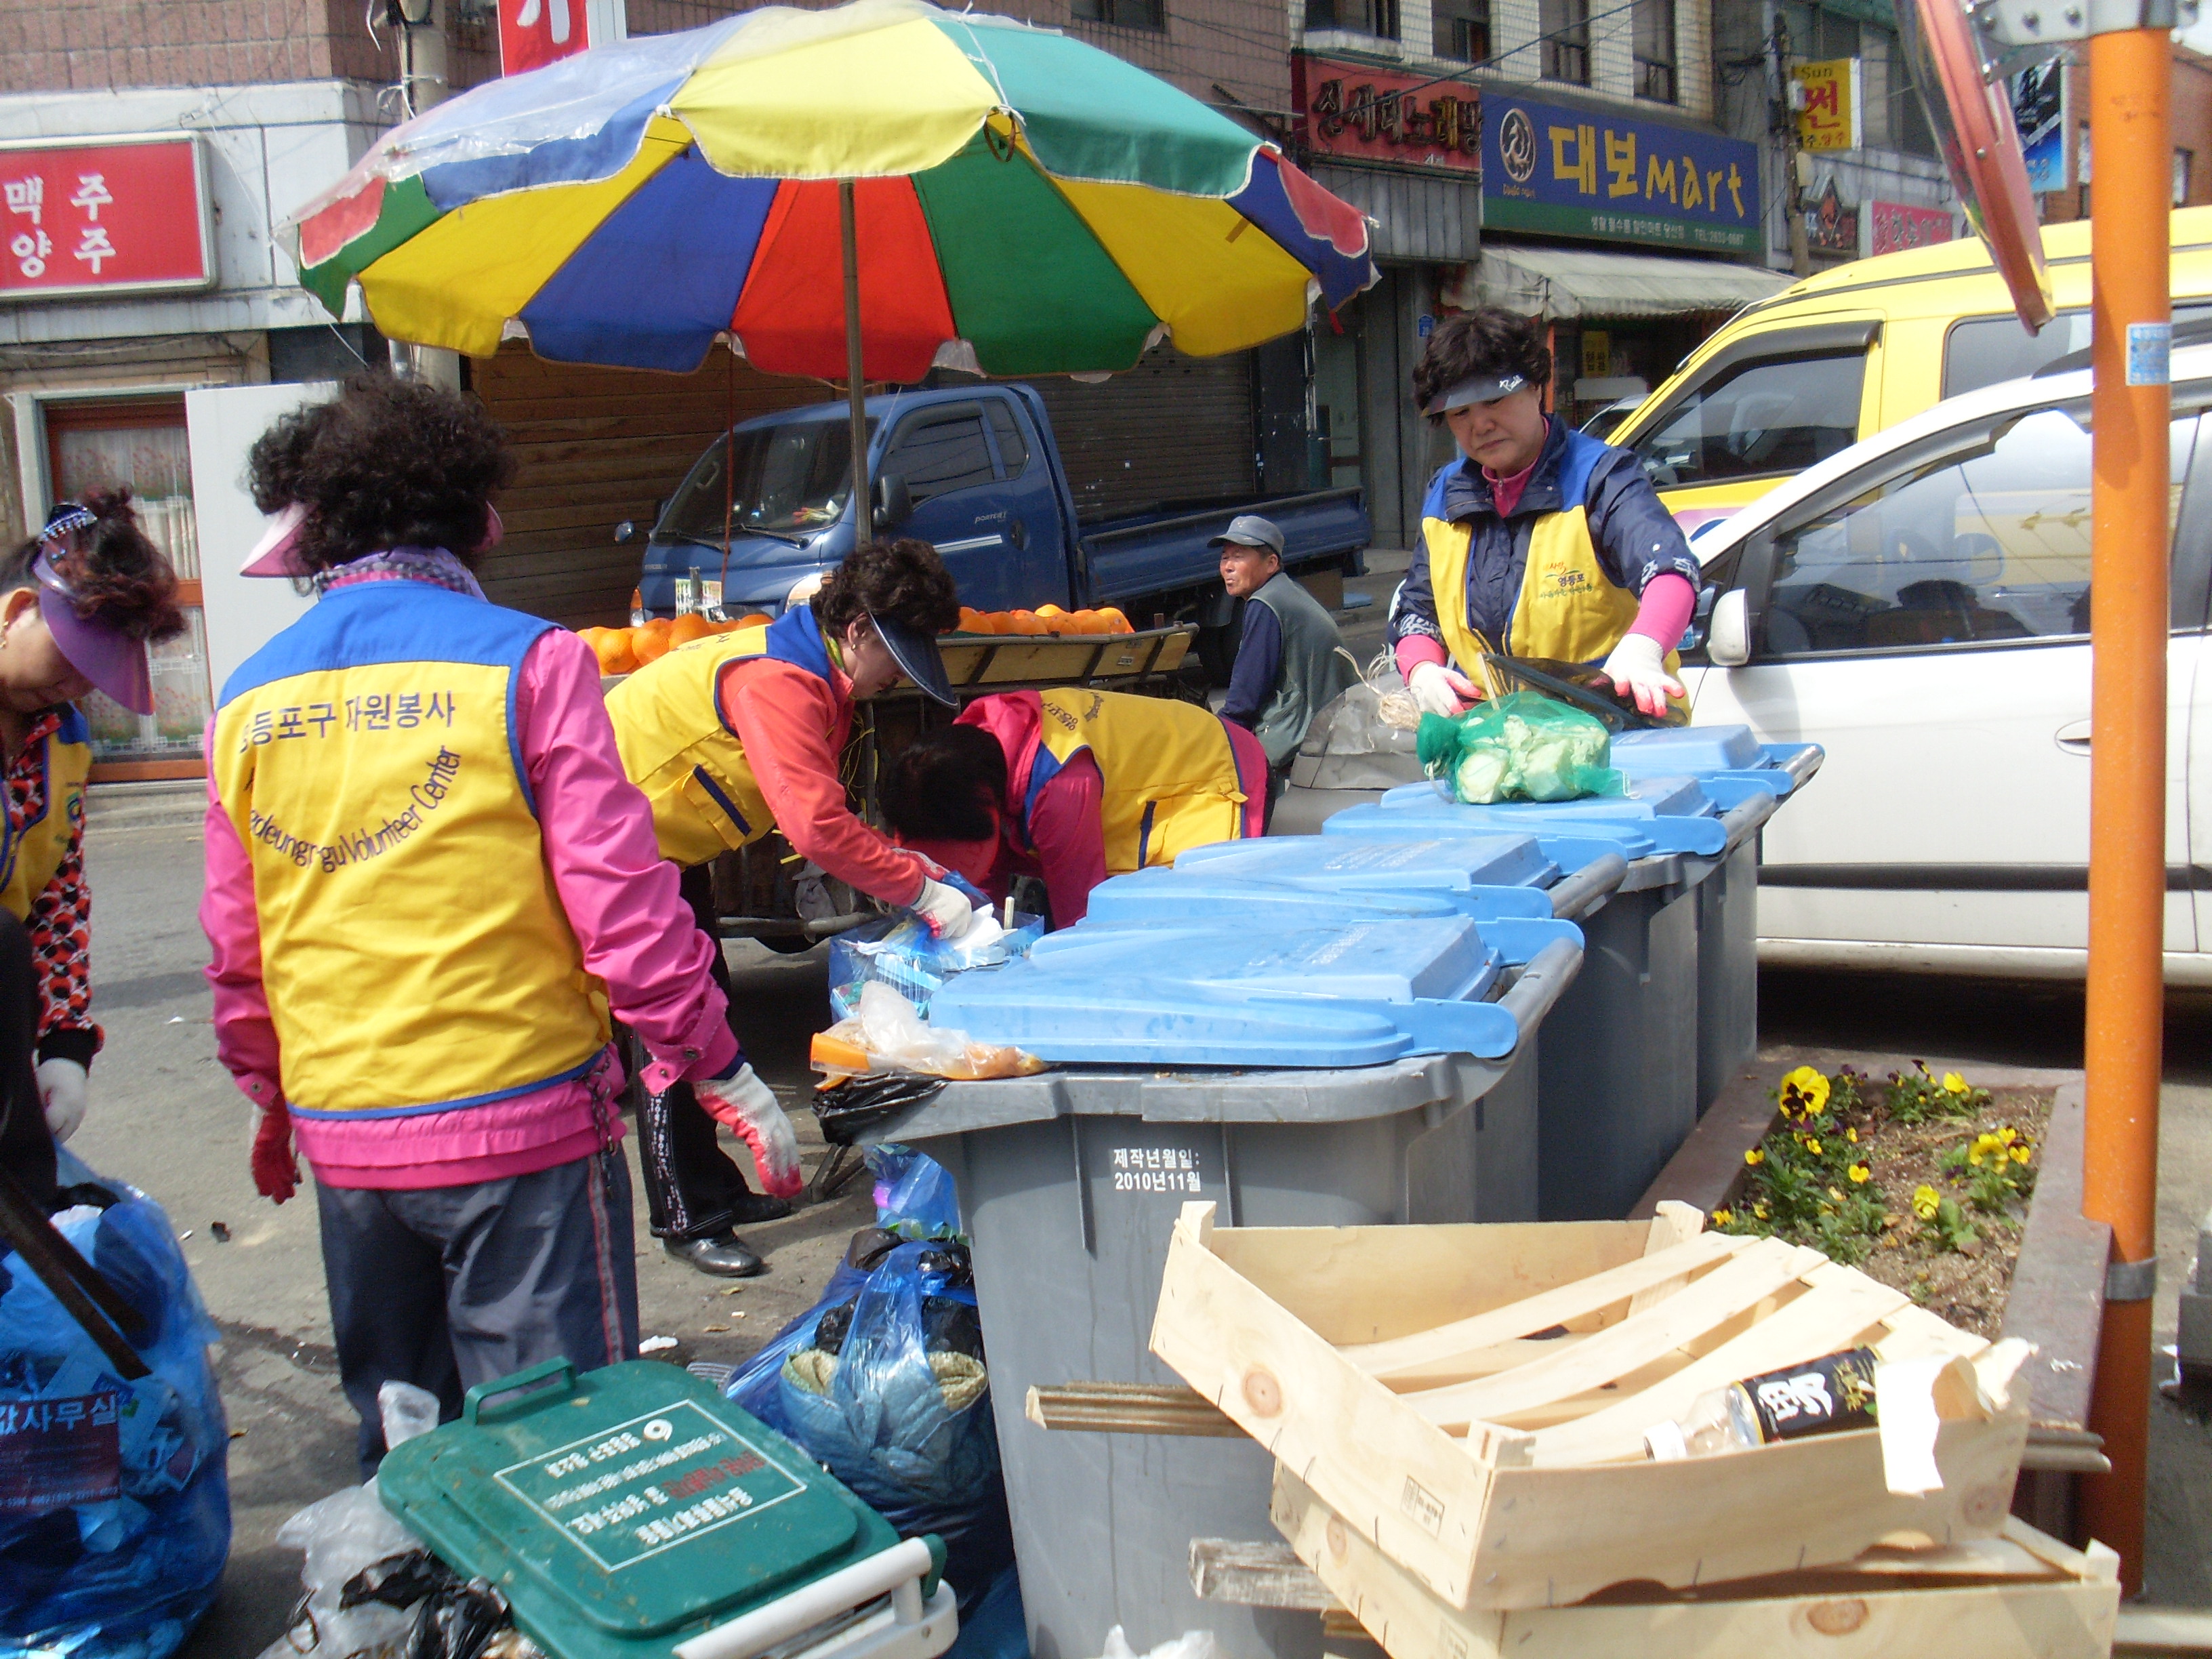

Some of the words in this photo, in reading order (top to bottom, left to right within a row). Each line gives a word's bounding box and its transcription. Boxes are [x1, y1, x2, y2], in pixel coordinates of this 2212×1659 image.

[1801, 66, 1832, 79] Sun
[410, 744, 462, 810] Center
[1113, 1148, 1200, 1168] 제작년월일:
[1114, 1171, 1202, 1191] 2010년11월
